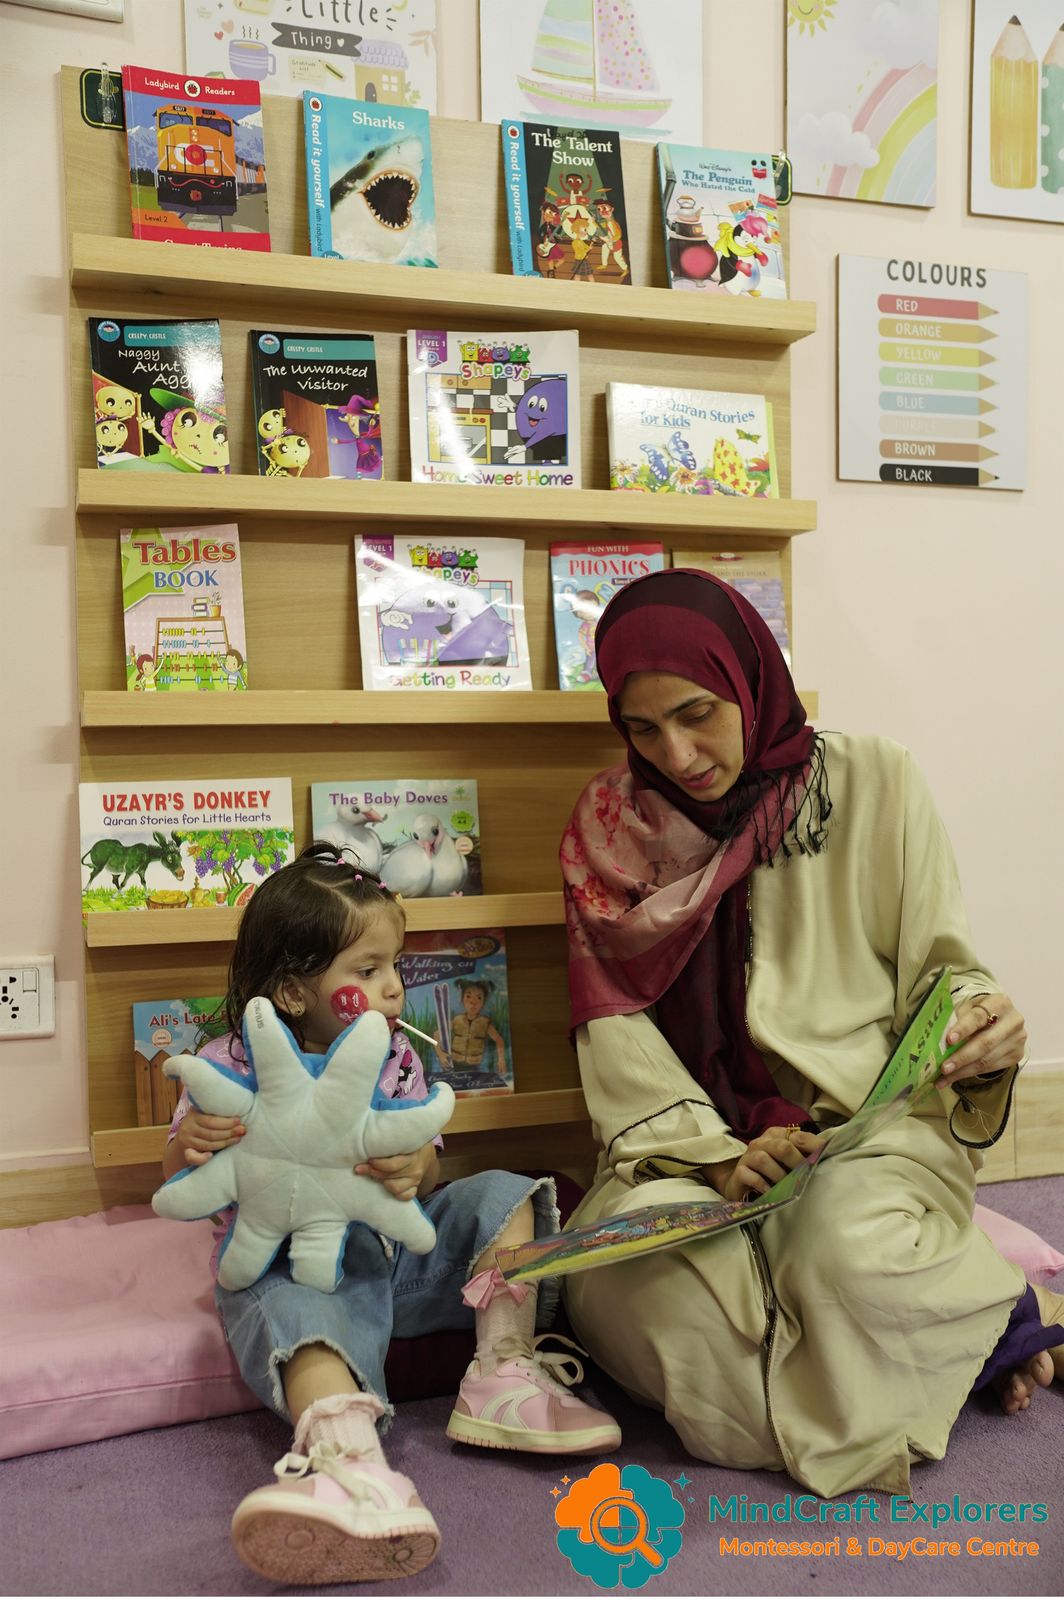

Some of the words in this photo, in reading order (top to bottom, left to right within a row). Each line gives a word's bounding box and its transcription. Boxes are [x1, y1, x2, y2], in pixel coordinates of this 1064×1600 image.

[301, 0, 378, 25] Little
[290, 31, 332, 49] Thing
[144, 77, 180, 90] Ladybird
[205, 86, 235, 96] Readers
[352, 111, 405, 130] Sharks
[311, 114, 322, 149] Read
[531, 132, 561, 148] The
[566, 137, 613, 152] Talent
[509, 142, 520, 171] Read
[552, 150, 594, 167] Show
[311, 158, 324, 208] yourself
[681, 180, 699, 188] Who
[701, 182, 722, 190] Hated
[724, 184, 736, 192] the
[683, 170, 704, 180] The
[708, 171, 752, 186] Penguin
[511, 181, 525, 230] yourself
[144, 214, 162, 222] Level
[886, 259, 987, 288] COLOURS
[896, 298, 918, 312] RED
[895, 324, 942, 338] ORANGE
[118, 350, 160, 361] Naggy
[896, 347, 942, 361] YELLOW
[132, 360, 181, 374] Aunt
[263, 365, 287, 377] The
[291, 364, 368, 378] Unwanted
[461, 363, 531, 381] Shapeys
[297, 377, 349, 391] Visitor
[896, 372, 934, 386] GREEN
[896, 395, 925, 409] BLUE
[640, 410, 659, 424] for
[663, 414, 691, 427] Kids
[710, 409, 755, 424] Stories
[895, 442, 936, 456] BROWN
[473, 470, 523, 485] Sweet
[527, 469, 573, 486] Home
[895, 468, 933, 482] BLACK
[133, 538, 236, 565] Tables
[587, 545, 603, 553] FUN
[606, 545, 629, 553] WITH
[568, 559, 650, 577] PHONICS
[154, 570, 219, 588] BOOK
[459, 670, 511, 688] Ready
[102, 792, 184, 812] UZAYR'S
[194, 790, 271, 810] DONKEY
[329, 793, 358, 806] The
[364, 792, 400, 807] Baby
[406, 791, 448, 804] Doves
[103, 816, 137, 826] Quran
[140, 814, 179, 826] Stories
[182, 814, 200, 825] for
[203, 812, 232, 824] Little
[235, 812, 271, 823] Hearts
[401, 957, 453, 972] Walking
[402, 972, 440, 985] Water
[149, 1014, 179, 1027] Ali's
[184, 1012, 216, 1025] Late
